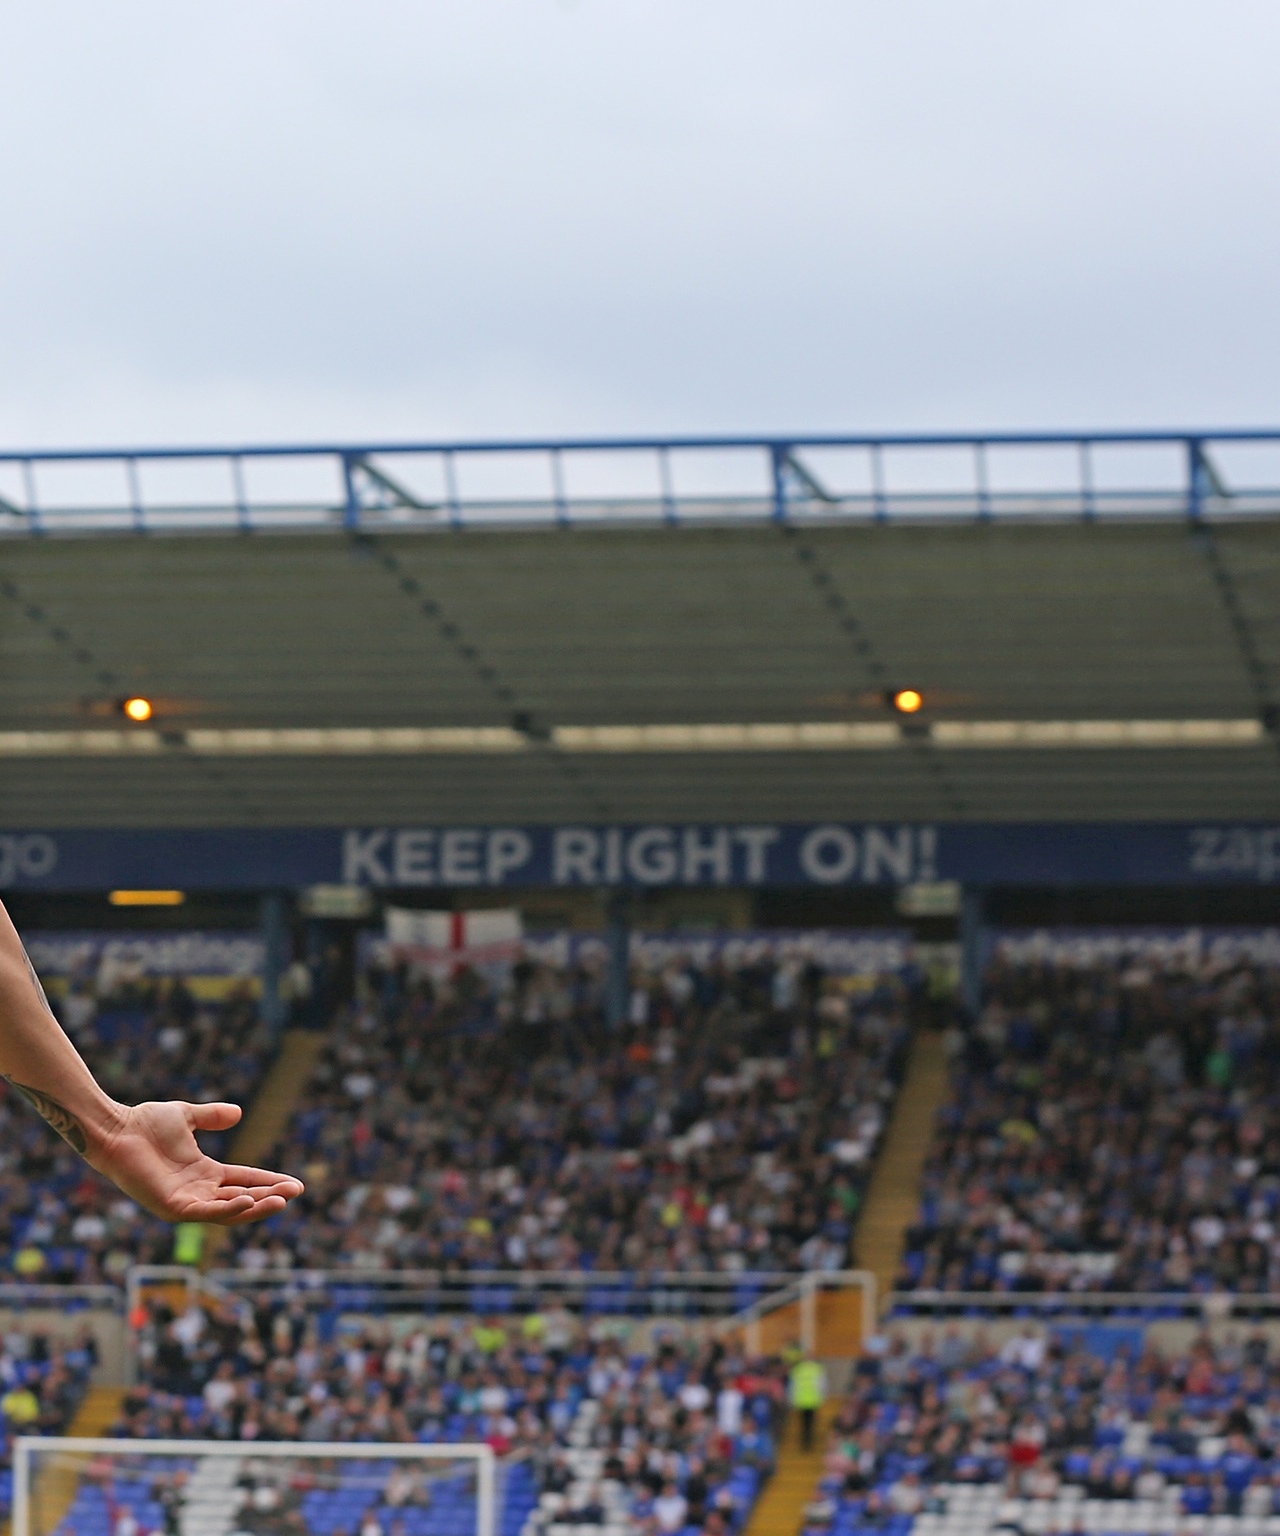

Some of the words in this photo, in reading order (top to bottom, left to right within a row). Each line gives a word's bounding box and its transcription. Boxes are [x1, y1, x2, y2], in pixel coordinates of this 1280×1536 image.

[340, 828, 533, 885] KEEP
[551, 826, 780, 885] RIGHT
[798, 825, 938, 885] ON!
